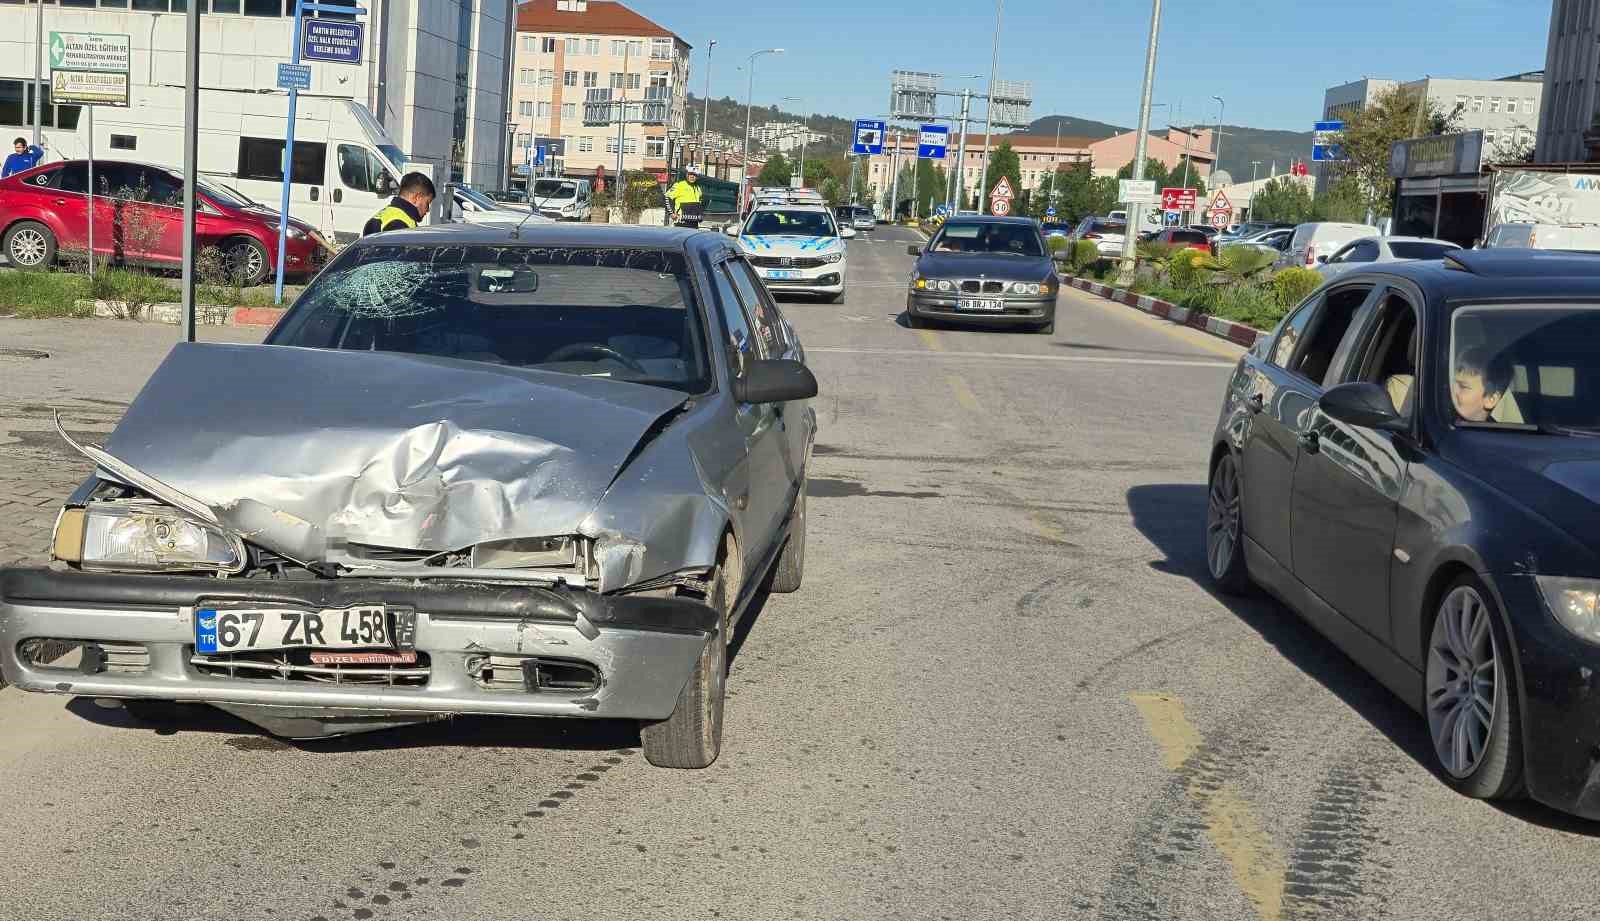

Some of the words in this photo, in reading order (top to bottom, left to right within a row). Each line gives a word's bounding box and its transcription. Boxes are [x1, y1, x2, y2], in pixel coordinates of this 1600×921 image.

[65, 43, 83, 51] ALTAN
[84, 43, 97, 51] ÖZEL
[99, 44, 119, 52] EĞİTİM
[120, 45, 127, 53] VE
[995, 203, 1006, 211] 30
[1215, 215, 1226, 224] 30
[961, 300, 970, 308] 06
[972, 300, 986, 308] BRJ
[989, 301, 1002, 309] 134
[217, 613, 265, 648] 67
[281, 613, 327, 646] ZR
[340, 610, 386, 645] 458
[201, 634, 216, 645] TR
